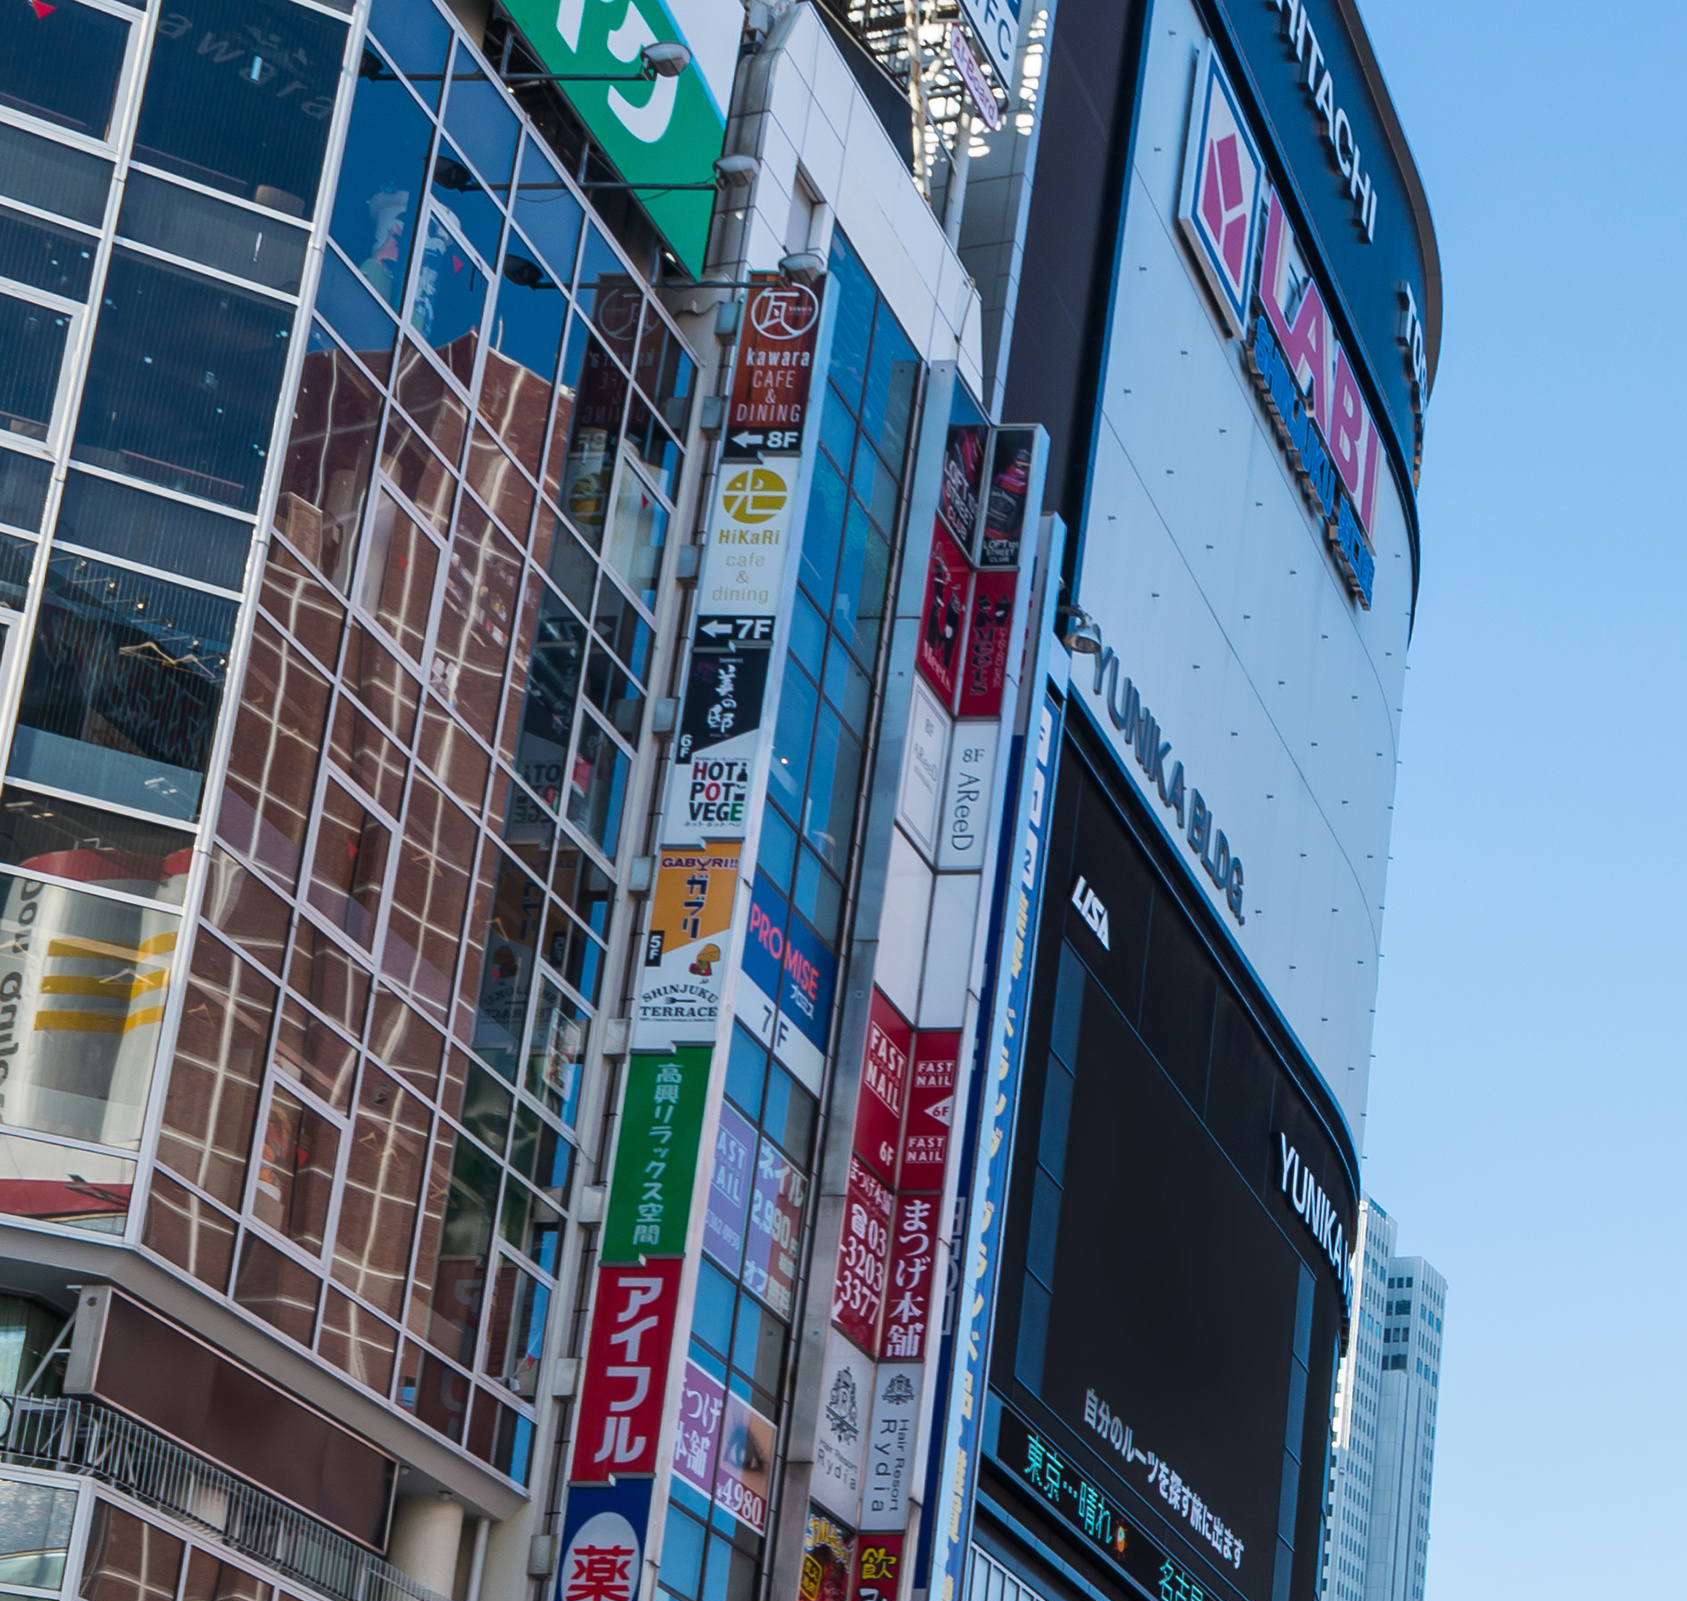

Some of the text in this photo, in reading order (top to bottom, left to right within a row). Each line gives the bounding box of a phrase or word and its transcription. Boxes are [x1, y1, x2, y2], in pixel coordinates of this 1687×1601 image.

[746, 348, 810, 367] kawara
[753, 371, 795, 388] CAFE
[1261, 188, 1383, 554] LABI
[736, 405, 800, 422] DINING
[1254, 316, 1336, 519] SHINJUKU
[725, 553, 765, 567] cafe
[712, 587, 768, 604] dining
[1092, 646, 1186, 830] YUNIKA
[692, 762, 738, 781] HOT
[690, 782, 736, 801] POT
[689, 803, 744, 821] VEGE
[682, 874, 708, 939] ガブリ
[1072, 876, 1110, 951] LISA
[749, 904, 820, 1001] PROMISE
[641, 985, 717, 1003] SHINJUKU
[640, 1006, 717, 1018] TERRACE
[871, 1023, 906, 1071] FAST
[918, 1062, 953, 1074] FAST
[866, 1064, 901, 1115] NAIL
[917, 1075, 952, 1088] NAIL
[908, 1138, 943, 1150] FAST
[632, 1063, 684, 1245] 高興リラックス空間
[907, 1150, 942, 1163] NAIL
[1280, 1132, 1343, 1280] YUNIKA
[886, 1199, 931, 1357] まつげ本舗
[594, 1277, 663, 1463] アイフル
[872, 1419, 897, 1512] Rydia
